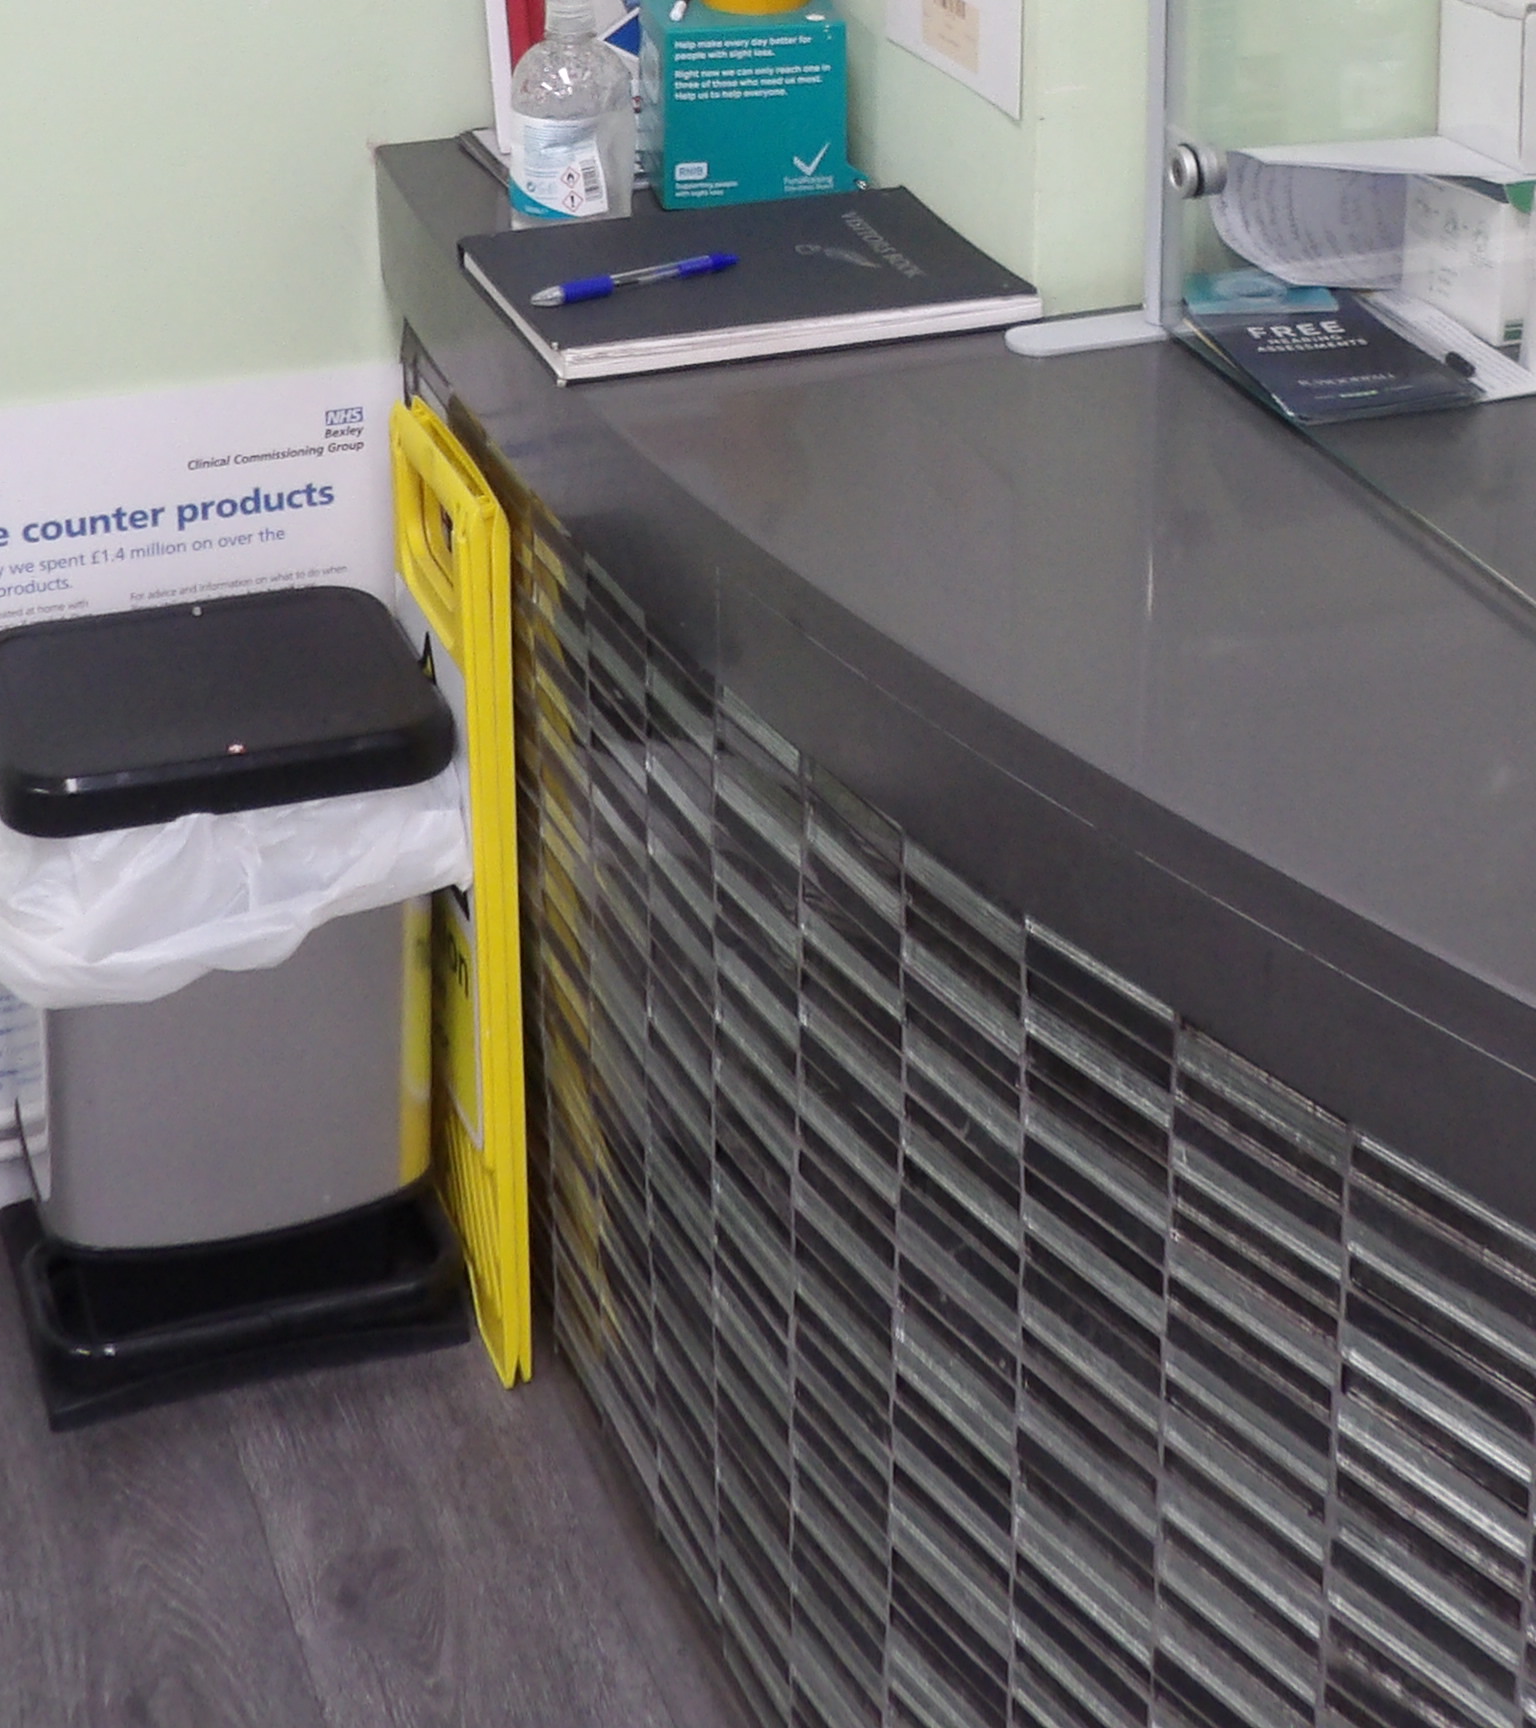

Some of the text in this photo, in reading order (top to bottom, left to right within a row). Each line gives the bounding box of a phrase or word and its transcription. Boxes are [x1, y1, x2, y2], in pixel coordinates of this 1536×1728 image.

[674, 41, 696, 50] Help
[724, 39, 749, 48] every
[751, 37, 768, 46] day
[769, 37, 797, 45] better
[1247, 320, 1346, 340] FREE
[325, 406, 363, 426] NHS
[324, 424, 363, 440] Bexley
[187, 439, 364, 471] Clinical Commissioning Group
[22, 506, 164, 545] counter
[176, 482, 335, 531] products
[9, 560, 35, 575] we
[38, 552, 87, 574] spent
[90, 548, 126, 567] £1.4
[130, 539, 188, 561] million
[192, 538, 213, 552] on
[216, 532, 254, 550] over
[257, 527, 286, 544] the
